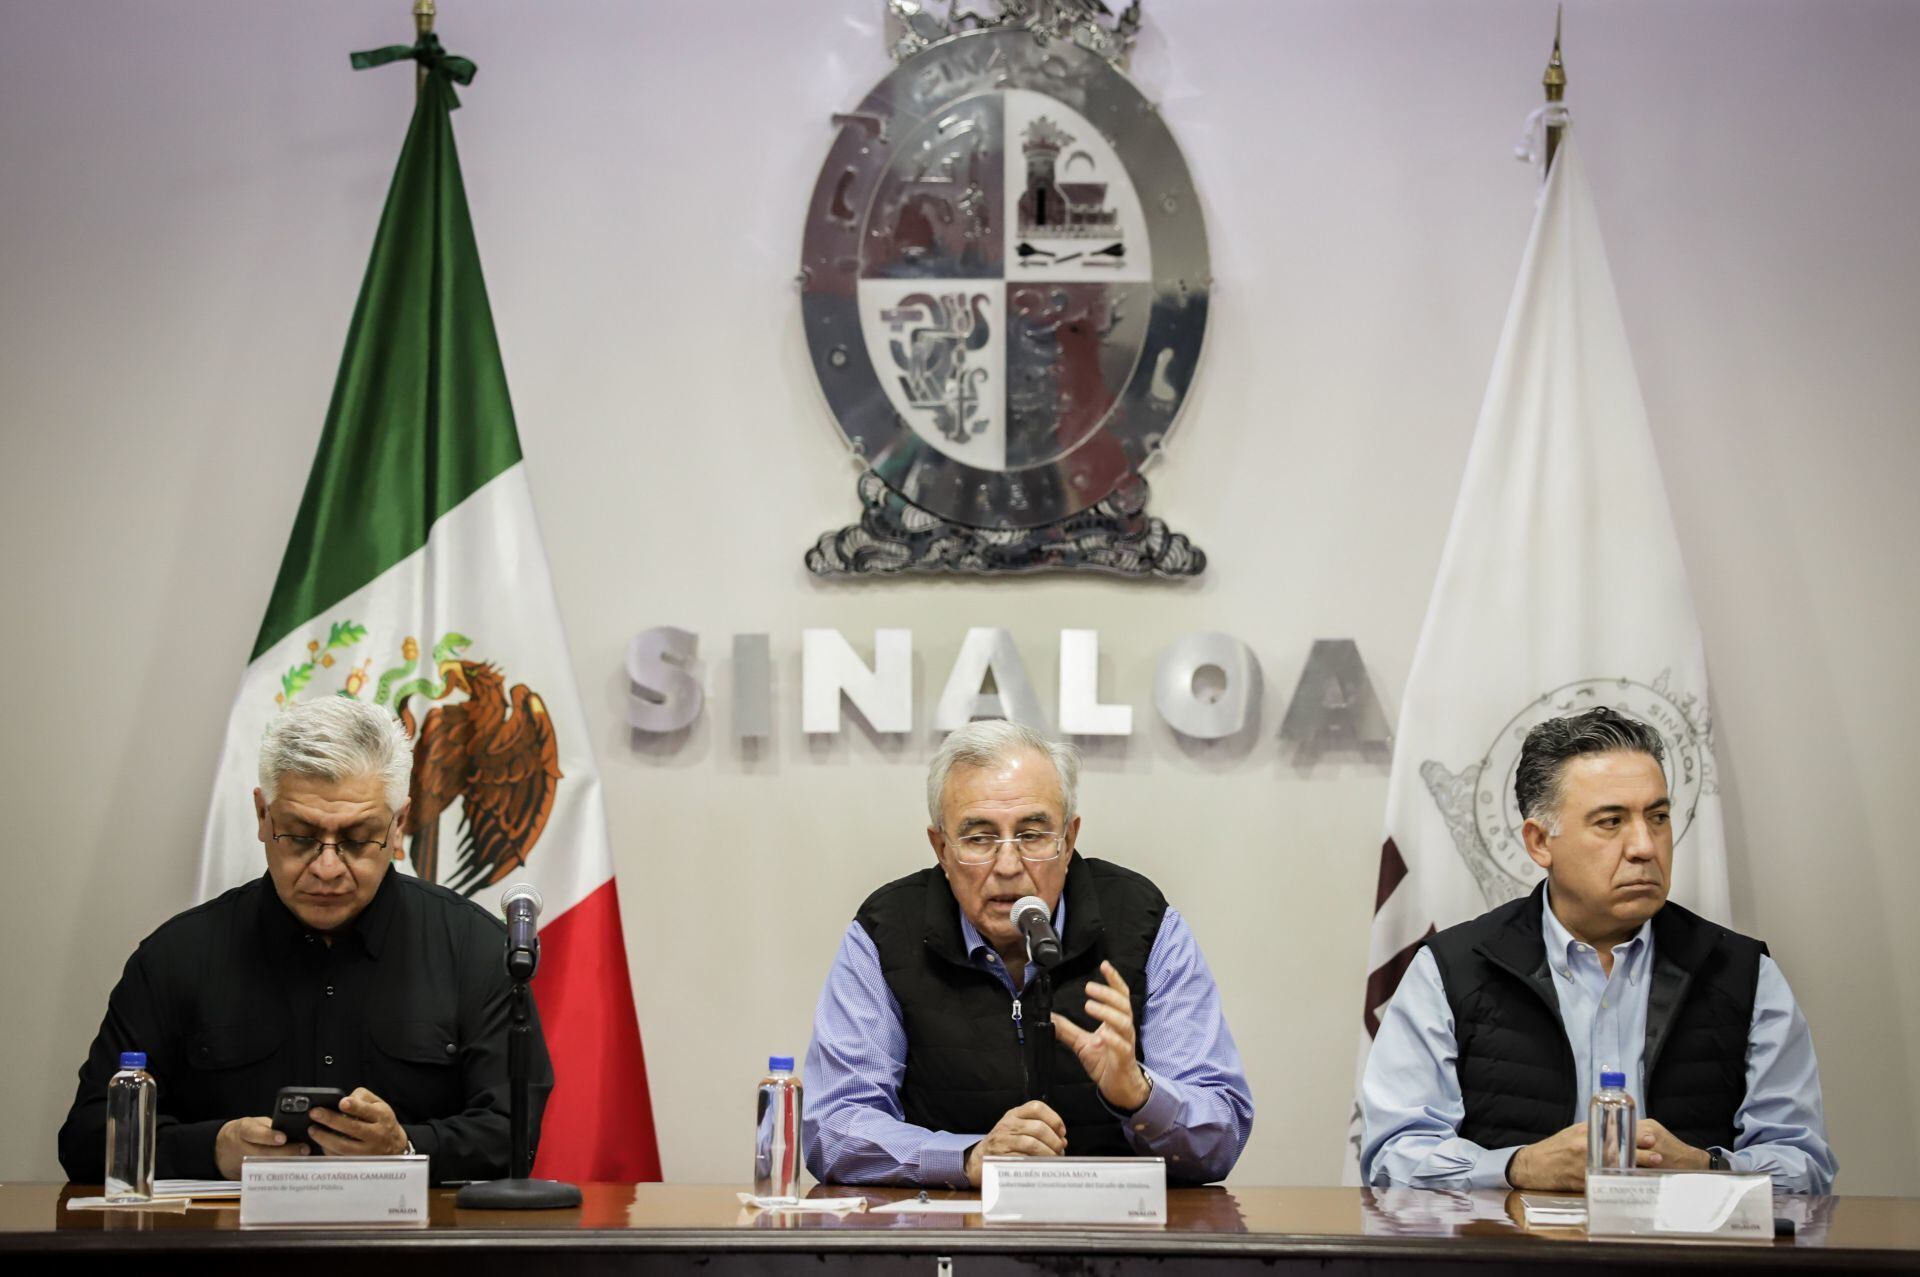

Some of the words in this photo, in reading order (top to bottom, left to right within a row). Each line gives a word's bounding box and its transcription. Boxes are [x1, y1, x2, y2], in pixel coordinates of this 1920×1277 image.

[626, 626, 1396, 742] SINALOA
[311, 1171, 358, 1181] CASTAÑEDA
[360, 1172, 407, 1181] CAMARILLO
[1072, 1171, 1098, 1179] MOYA
